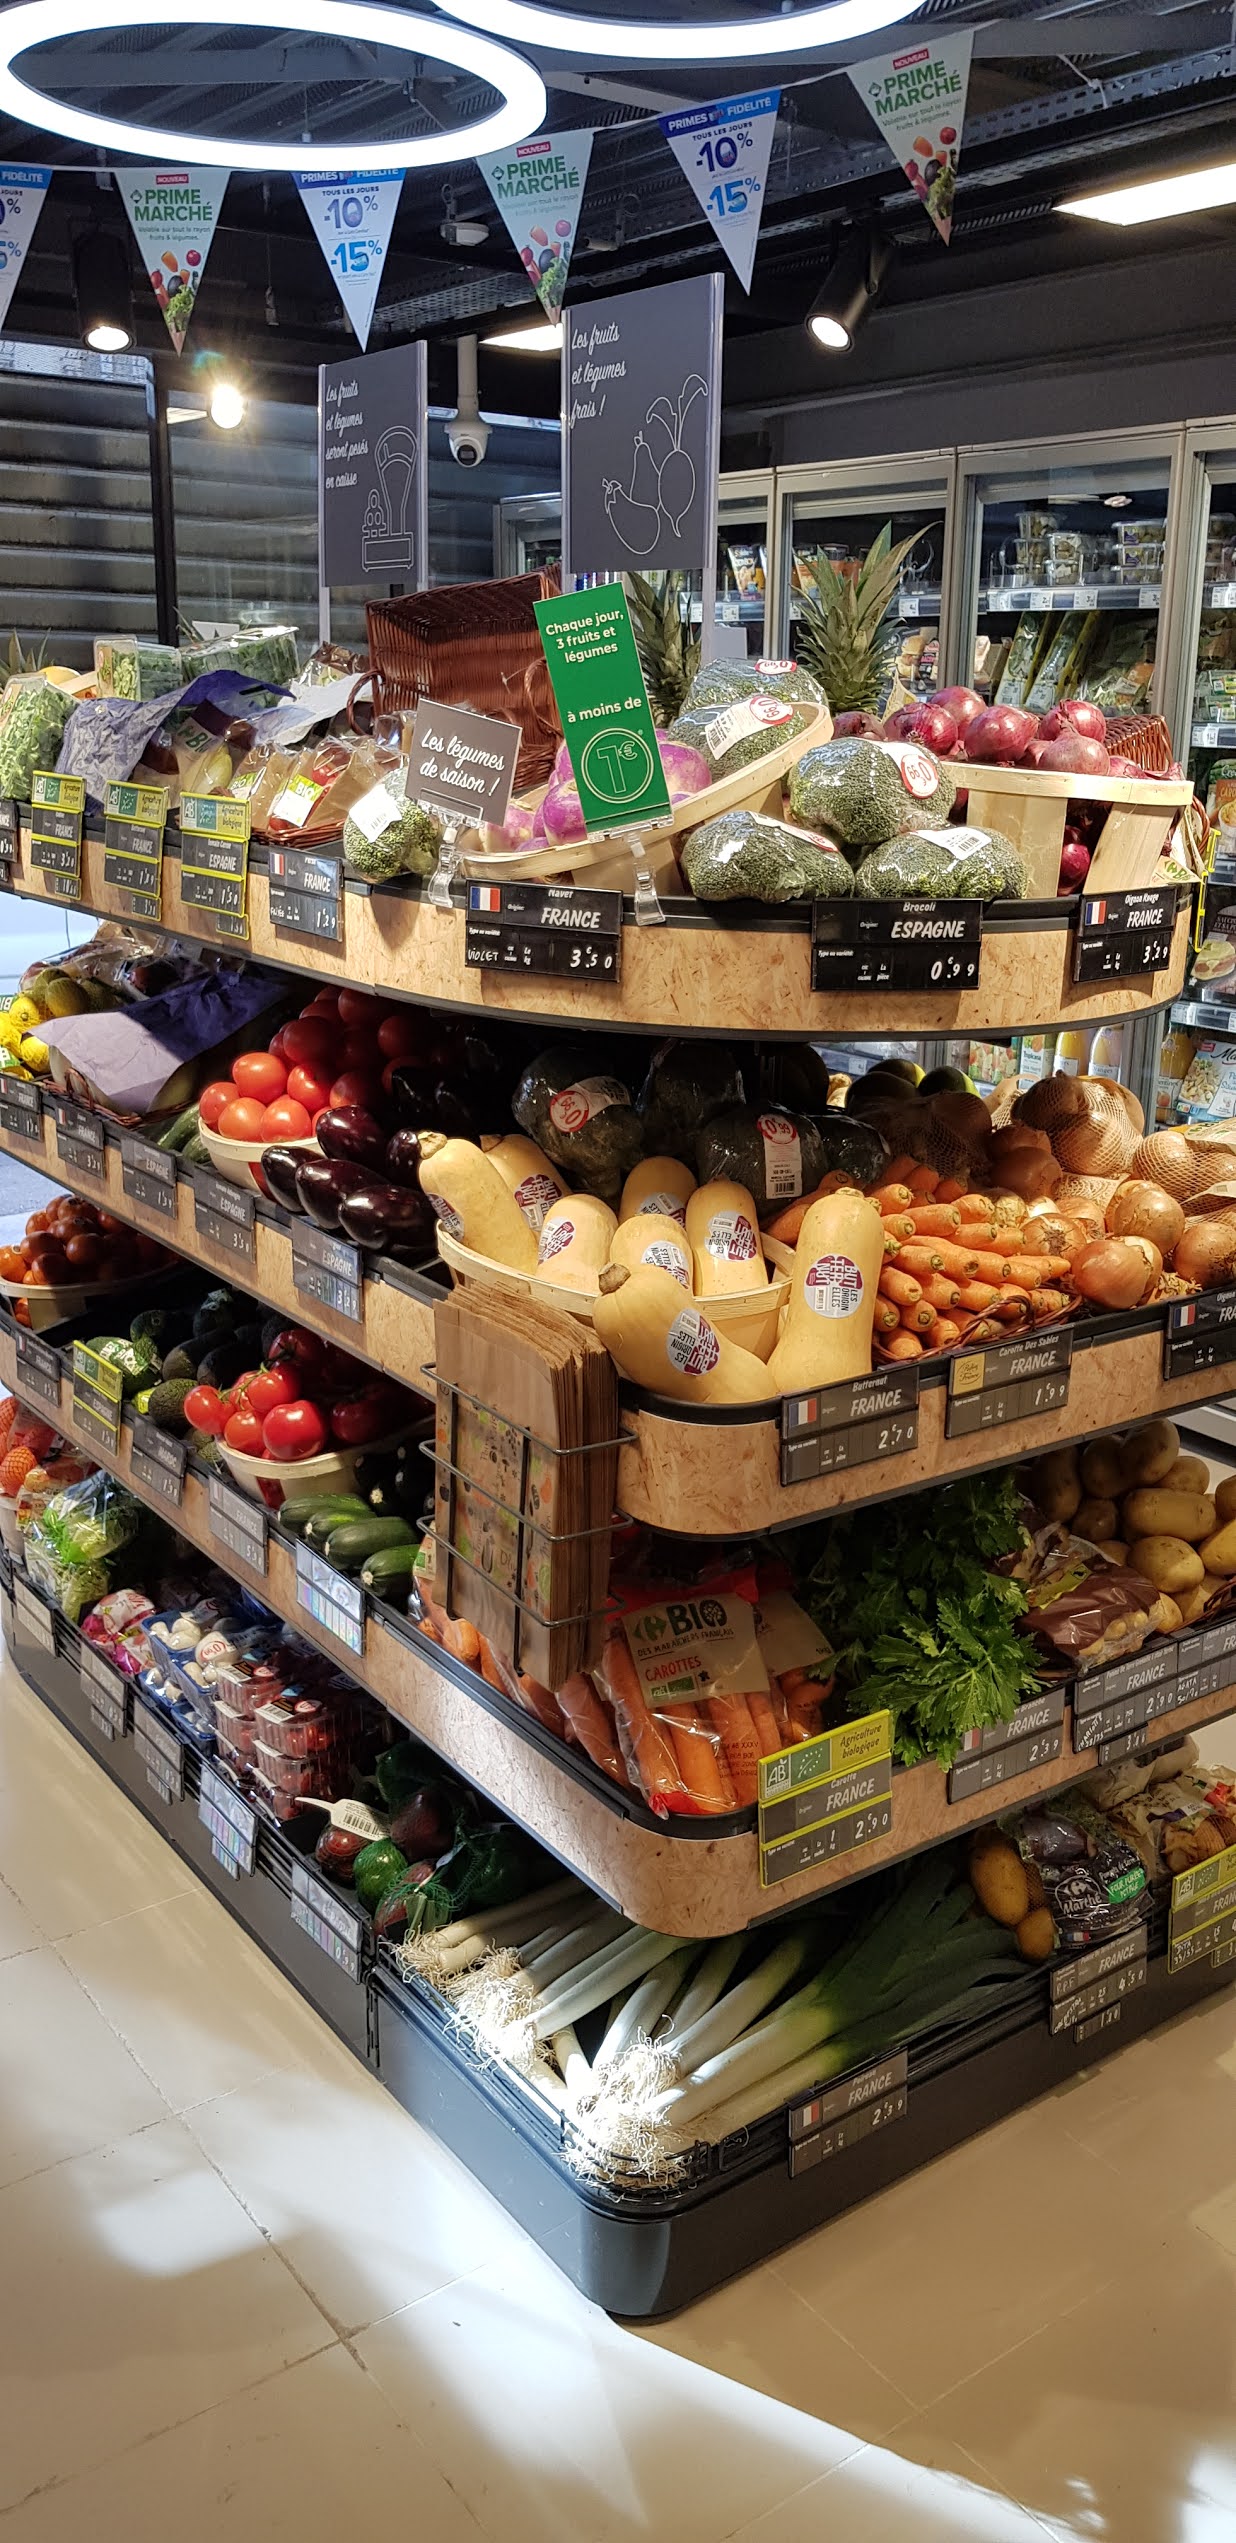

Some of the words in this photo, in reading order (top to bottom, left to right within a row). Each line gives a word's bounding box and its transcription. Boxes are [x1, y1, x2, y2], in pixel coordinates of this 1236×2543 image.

[894, 51, 927, 67] NOUVEAU
[884, 60, 946, 95] PRIME
[874, 70, 962, 117] MARCHÉ
[668, 113, 708, 131] PRIMES
[692, 131, 712, 141] TOUS
[714, 128, 727, 136] LES
[729, 121, 753, 132] JOURS
[518, 143, 550, 155] NOUVEAU
[157, 175, 187, 184] NOUVEAU
[301, 172, 338, 183] PRIMES
[507, 156, 566, 180] PRIME
[356, 186, 379, 194] JOURS
[497, 166, 580, 199] MARCHÉ
[145, 189, 201, 205] PRIME
[134, 201, 213, 222] MARCHÉ
[571, 328, 589, 350] Les
[588, 321, 620, 356] fruits
[571, 367, 583, 385] et
[584, 360, 626, 393] légumes
[326, 384, 338, 403] Les
[337, 379, 359, 408] fruits
[326, 415, 334, 432] et
[333, 411, 363, 438] légumes
[570, 398, 597, 430] frais
[325, 441, 349, 460] seront
[348, 439, 369, 462] posés
[326, 477, 335, 489] en
[336, 471, 358, 488] caisse
[545, 617, 594, 637] Chaque
[594, 609, 624, 629] jour,
[556, 637, 565, 650] 3
[567, 630, 601, 648] fruits
[603, 626, 617, 639] et
[564, 642, 618, 664] légumes
[567, 711, 577, 724] à
[579, 701, 621, 721] moins
[624, 697, 642, 711] de
[421, 728, 444, 753] Les
[447, 735, 505, 771] légumes
[420, 757, 438, 779] de
[439, 766, 485, 794] saison
[295, 783, 316, 797] BIO
[209, 853, 237, 872] ESPAGNE
[303, 873, 331, 893] FRANCE
[548, 889, 574, 899] Navet
[541, 907, 601, 929] FRANCE
[903, 902, 936, 912] Brocoli
[1126, 908, 1164, 928] FRANCE
[891, 920, 966, 939] ESPAGNE
[220, 1198, 246, 1222] ESPAGNE
[322, 1251, 353, 1277] ESPAGNE
[815, 1263, 830, 1285] NUT
[844, 1265, 857, 1288] BUT
[831, 1287, 841, 1308] ELLES
[840, 1288, 850, 1312] ORIGIN
[850, 1289, 858, 1302] LES
[678, 1330, 696, 1345] ELLES
[999, 1346, 1024, 1357] Carotte
[1025, 1341, 1037, 1349] Des
[1038, 1335, 1060, 1347] Sables
[674, 1353, 689, 1364] LES
[1010, 1350, 1056, 1376] FRANCE
[852, 1375, 888, 1392] Butternut
[850, 1389, 902, 1417] FRANCE
[666, 1600, 728, 1636] BIO
[645, 1655, 702, 1682] CAROTTES
[1127, 1663, 1166, 1691] FRANCE
[1007, 1708, 1051, 1738] FRANCE
[768, 1763, 787, 1787] AB
[840, 1724, 882, 1747] Agriculture
[842, 1737, 880, 1759] biologique
[831, 1772, 857, 1789] Carotte
[826, 1778, 876, 1812] FRANCE
[1098, 1944, 1135, 1974] FRANCE
[848, 2072, 893, 2106] FRANCE
